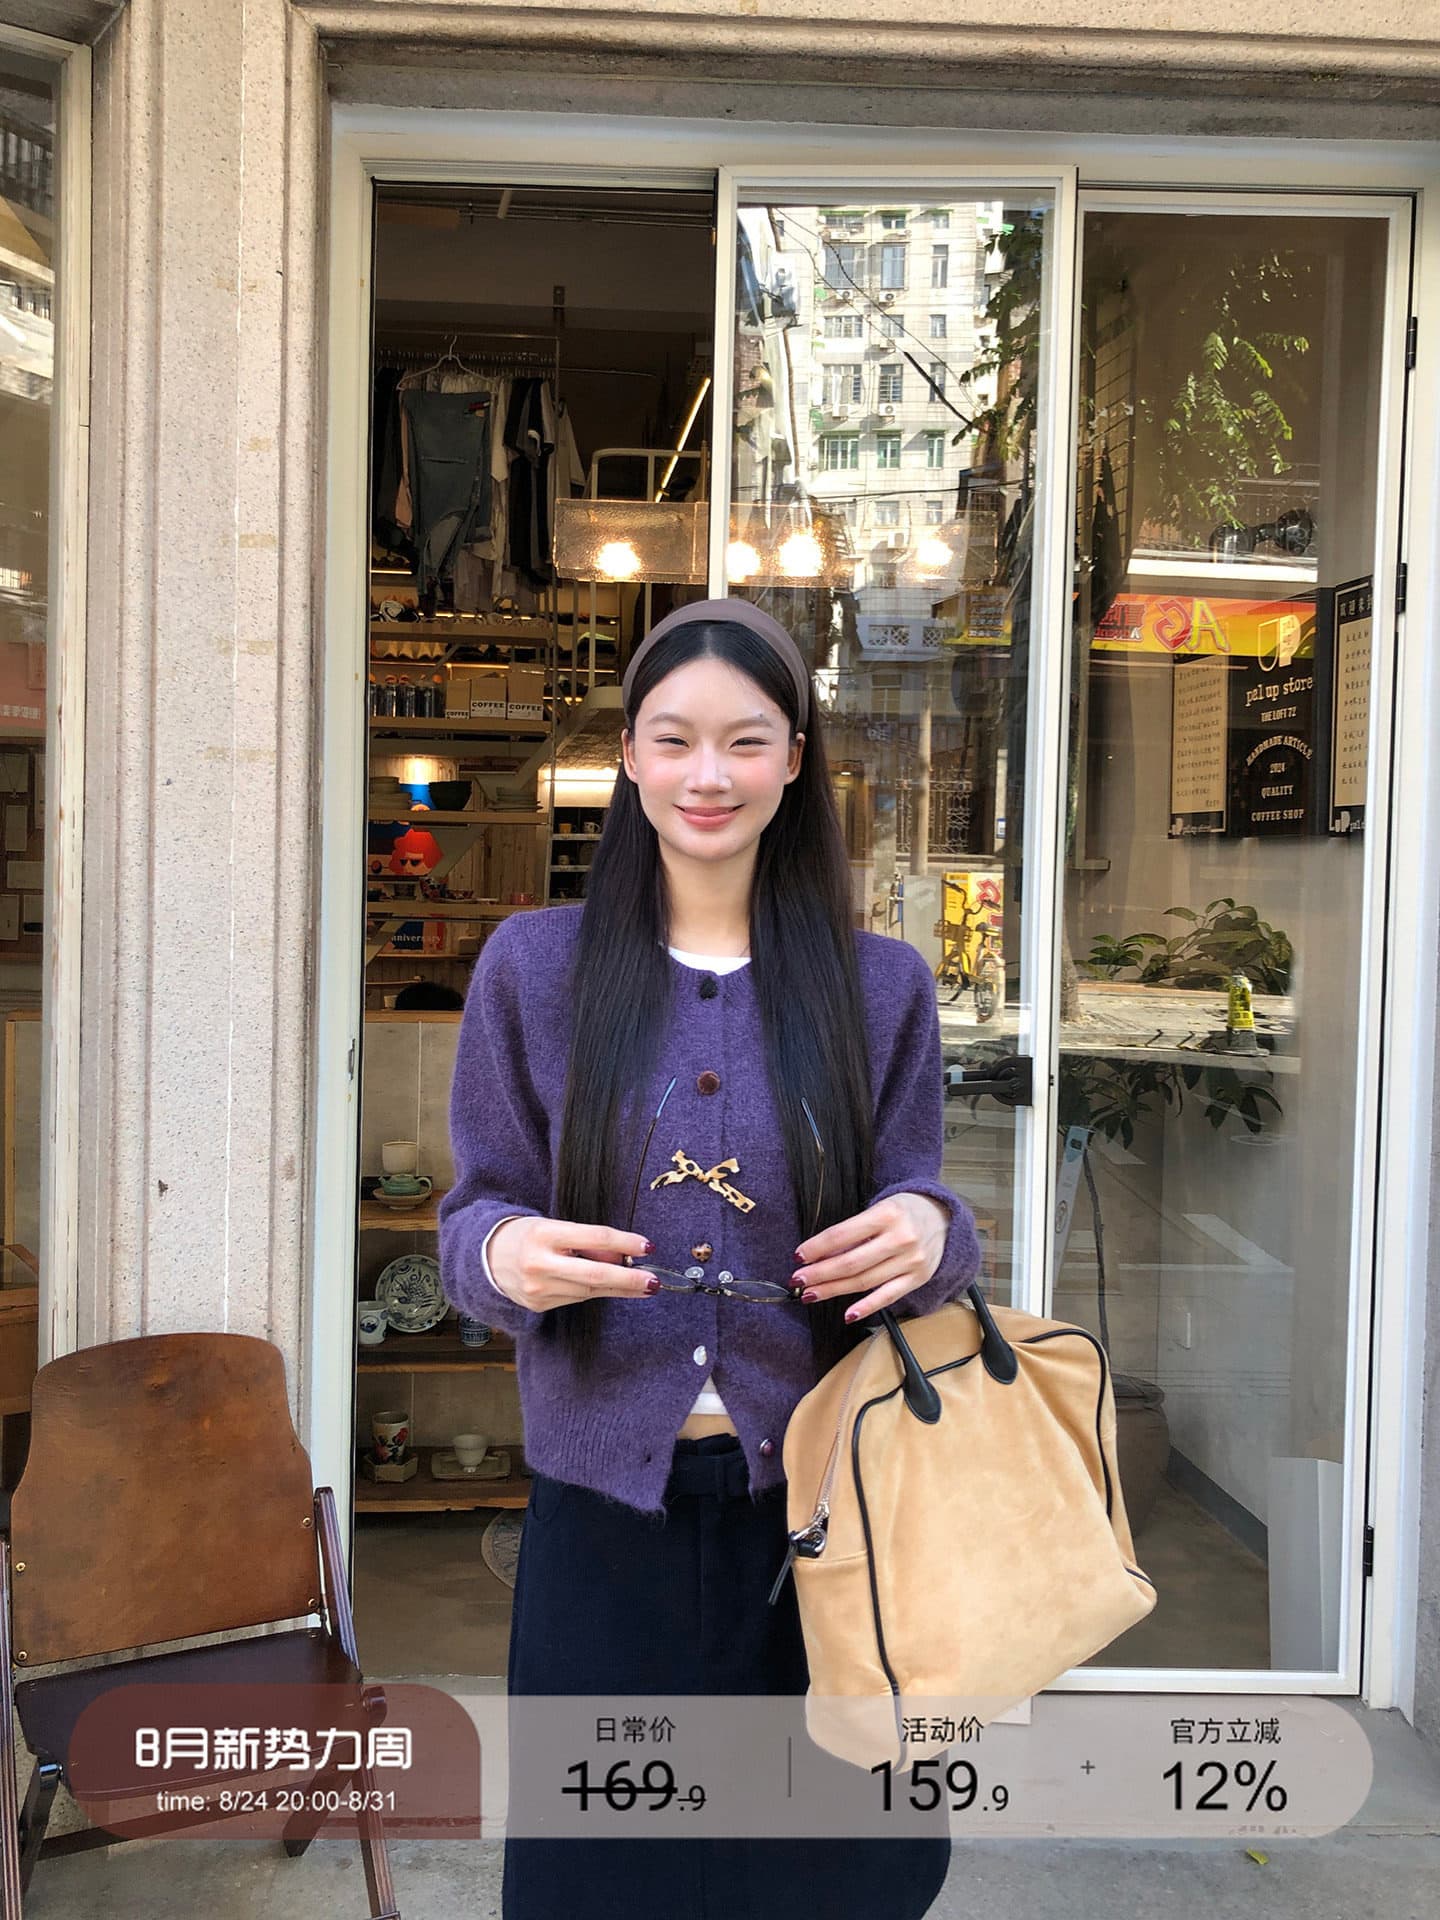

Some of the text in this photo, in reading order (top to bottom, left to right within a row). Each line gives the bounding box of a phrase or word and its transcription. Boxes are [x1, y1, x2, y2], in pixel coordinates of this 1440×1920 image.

[1265, 684, 1280, 702] up
[1282, 676, 1313, 696] store
[471, 701, 505, 709] COFFEE
[508, 703, 542, 712] COFFEE
[1245, 735, 1314, 767] HANDMADE ARTICLE
[1261, 784, 1294, 800] QUALITY
[1251, 808, 1305, 822] COFFEE SHOP
